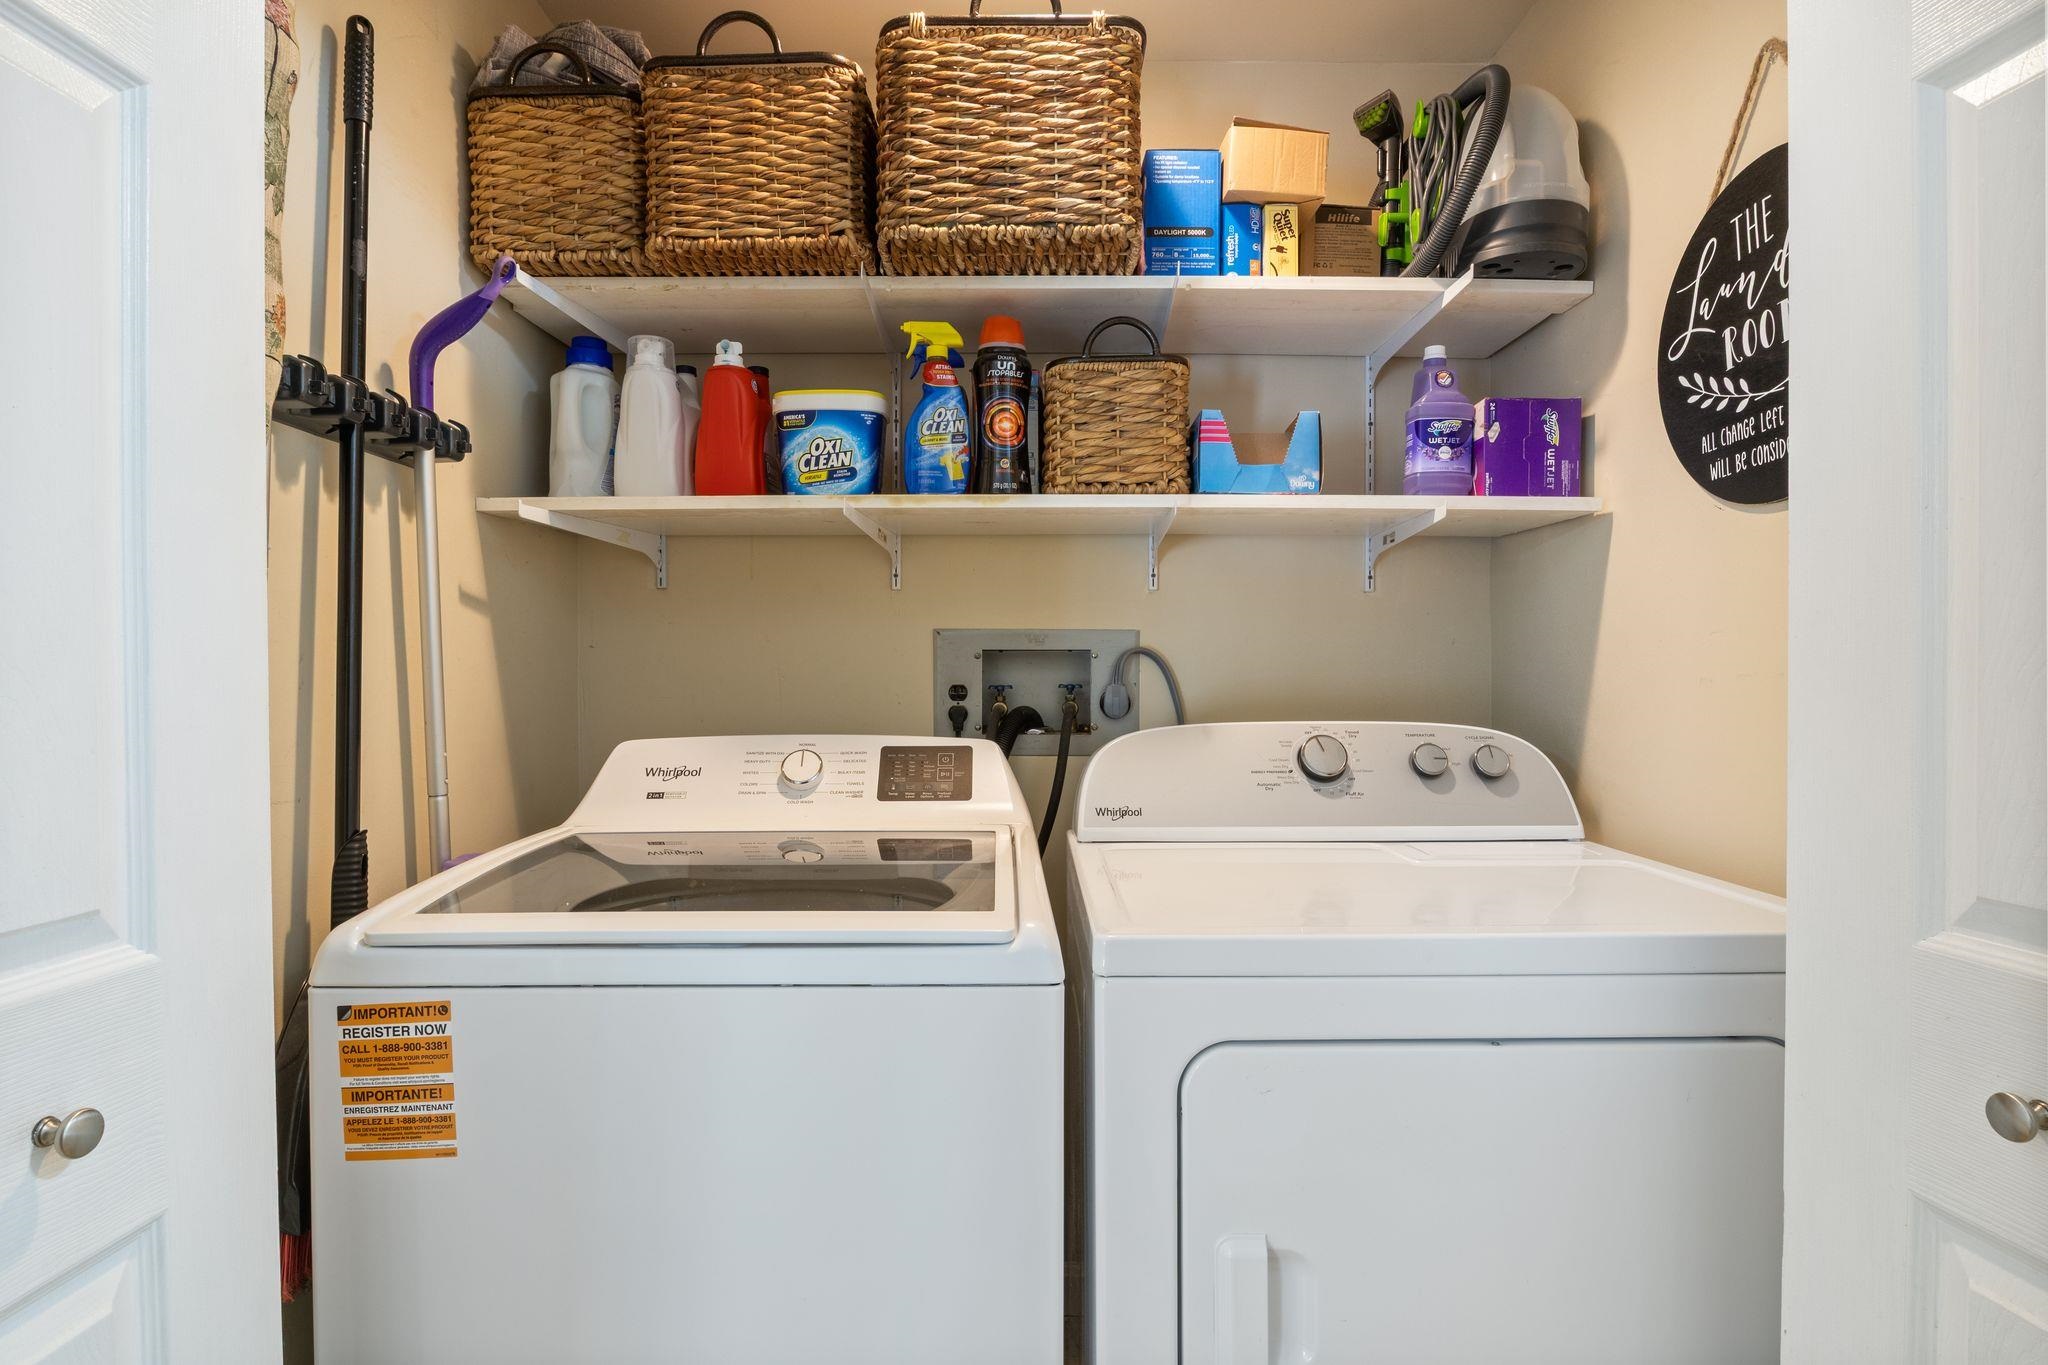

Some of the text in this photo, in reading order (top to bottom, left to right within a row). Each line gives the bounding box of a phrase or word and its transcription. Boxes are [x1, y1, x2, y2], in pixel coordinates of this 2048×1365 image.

[1282, 209, 1297, 239] Super
[1327, 213, 1360, 223] Hilife
[1273, 212, 1289, 242] Quiet
[1730, 194, 1774, 261] THE
[1226, 236, 1235, 266] refresh
[987, 370, 1024, 378] STOPABLES
[1490, 402, 1496, 410] 24
[921, 420, 965, 435] CLEAN
[1428, 421, 1462, 435] Swiffer
[810, 437, 842, 456] OXI
[1544, 408, 1559, 489] Swiffer WETJET
[1702, 432, 1717, 454] ALL
[799, 451, 852, 473] CLEAN
[1290, 479, 1315, 489] Downy
[645, 765, 702, 781] Whirlpool
[1095, 805, 1142, 821] Whirlpool
[354, 1005, 437, 1020] IMPORTANT!
[342, 1023, 447, 1039] REGISTER NOW
[342, 1042, 448, 1054] CALL 1-888-900-3381
[351, 1088, 442, 1102] IMPORTANTE!
[344, 1103, 453, 1114] ENREGISTREZ MAINTENANT
[346, 1115, 452, 1126] APPELEZ LE 1-888-900-3381
